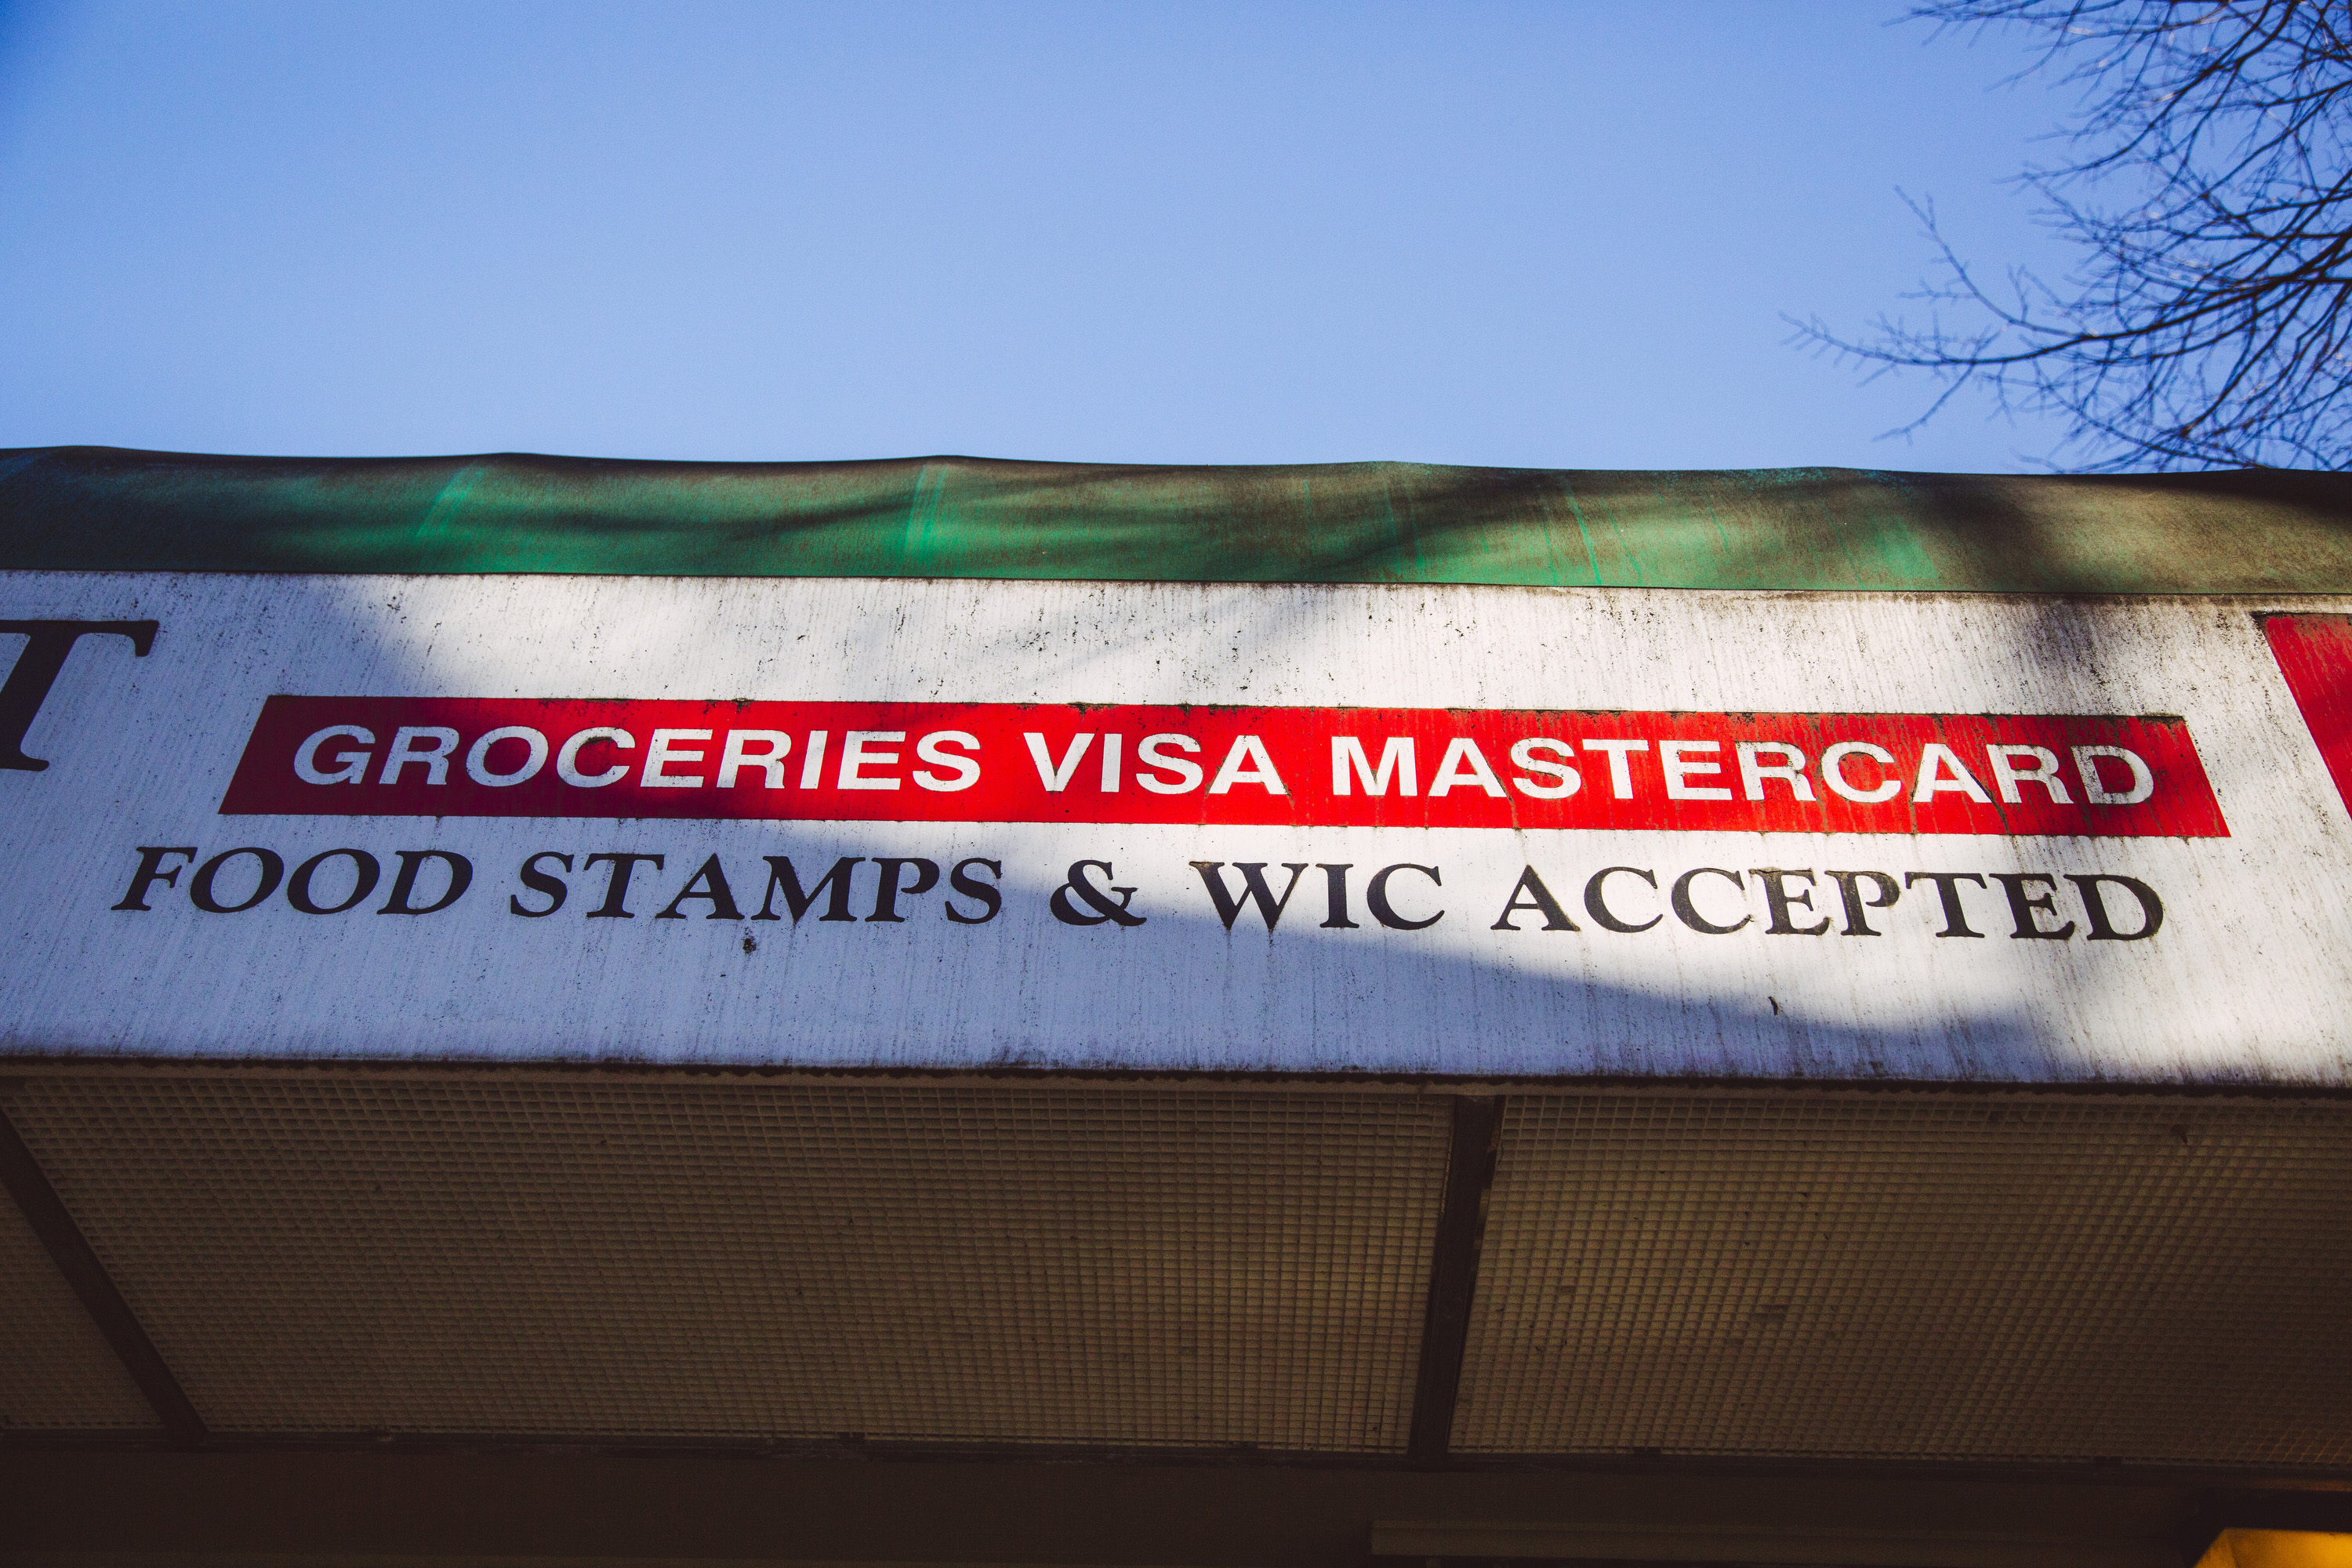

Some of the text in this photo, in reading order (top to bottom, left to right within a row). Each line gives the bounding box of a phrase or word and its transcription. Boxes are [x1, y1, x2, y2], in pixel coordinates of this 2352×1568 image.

[293, 724, 2154, 805] GROCERIES VISA MASTERCARD
[111, 846, 2164, 941] FOOD STAMPS & WIC ACCEPTED
